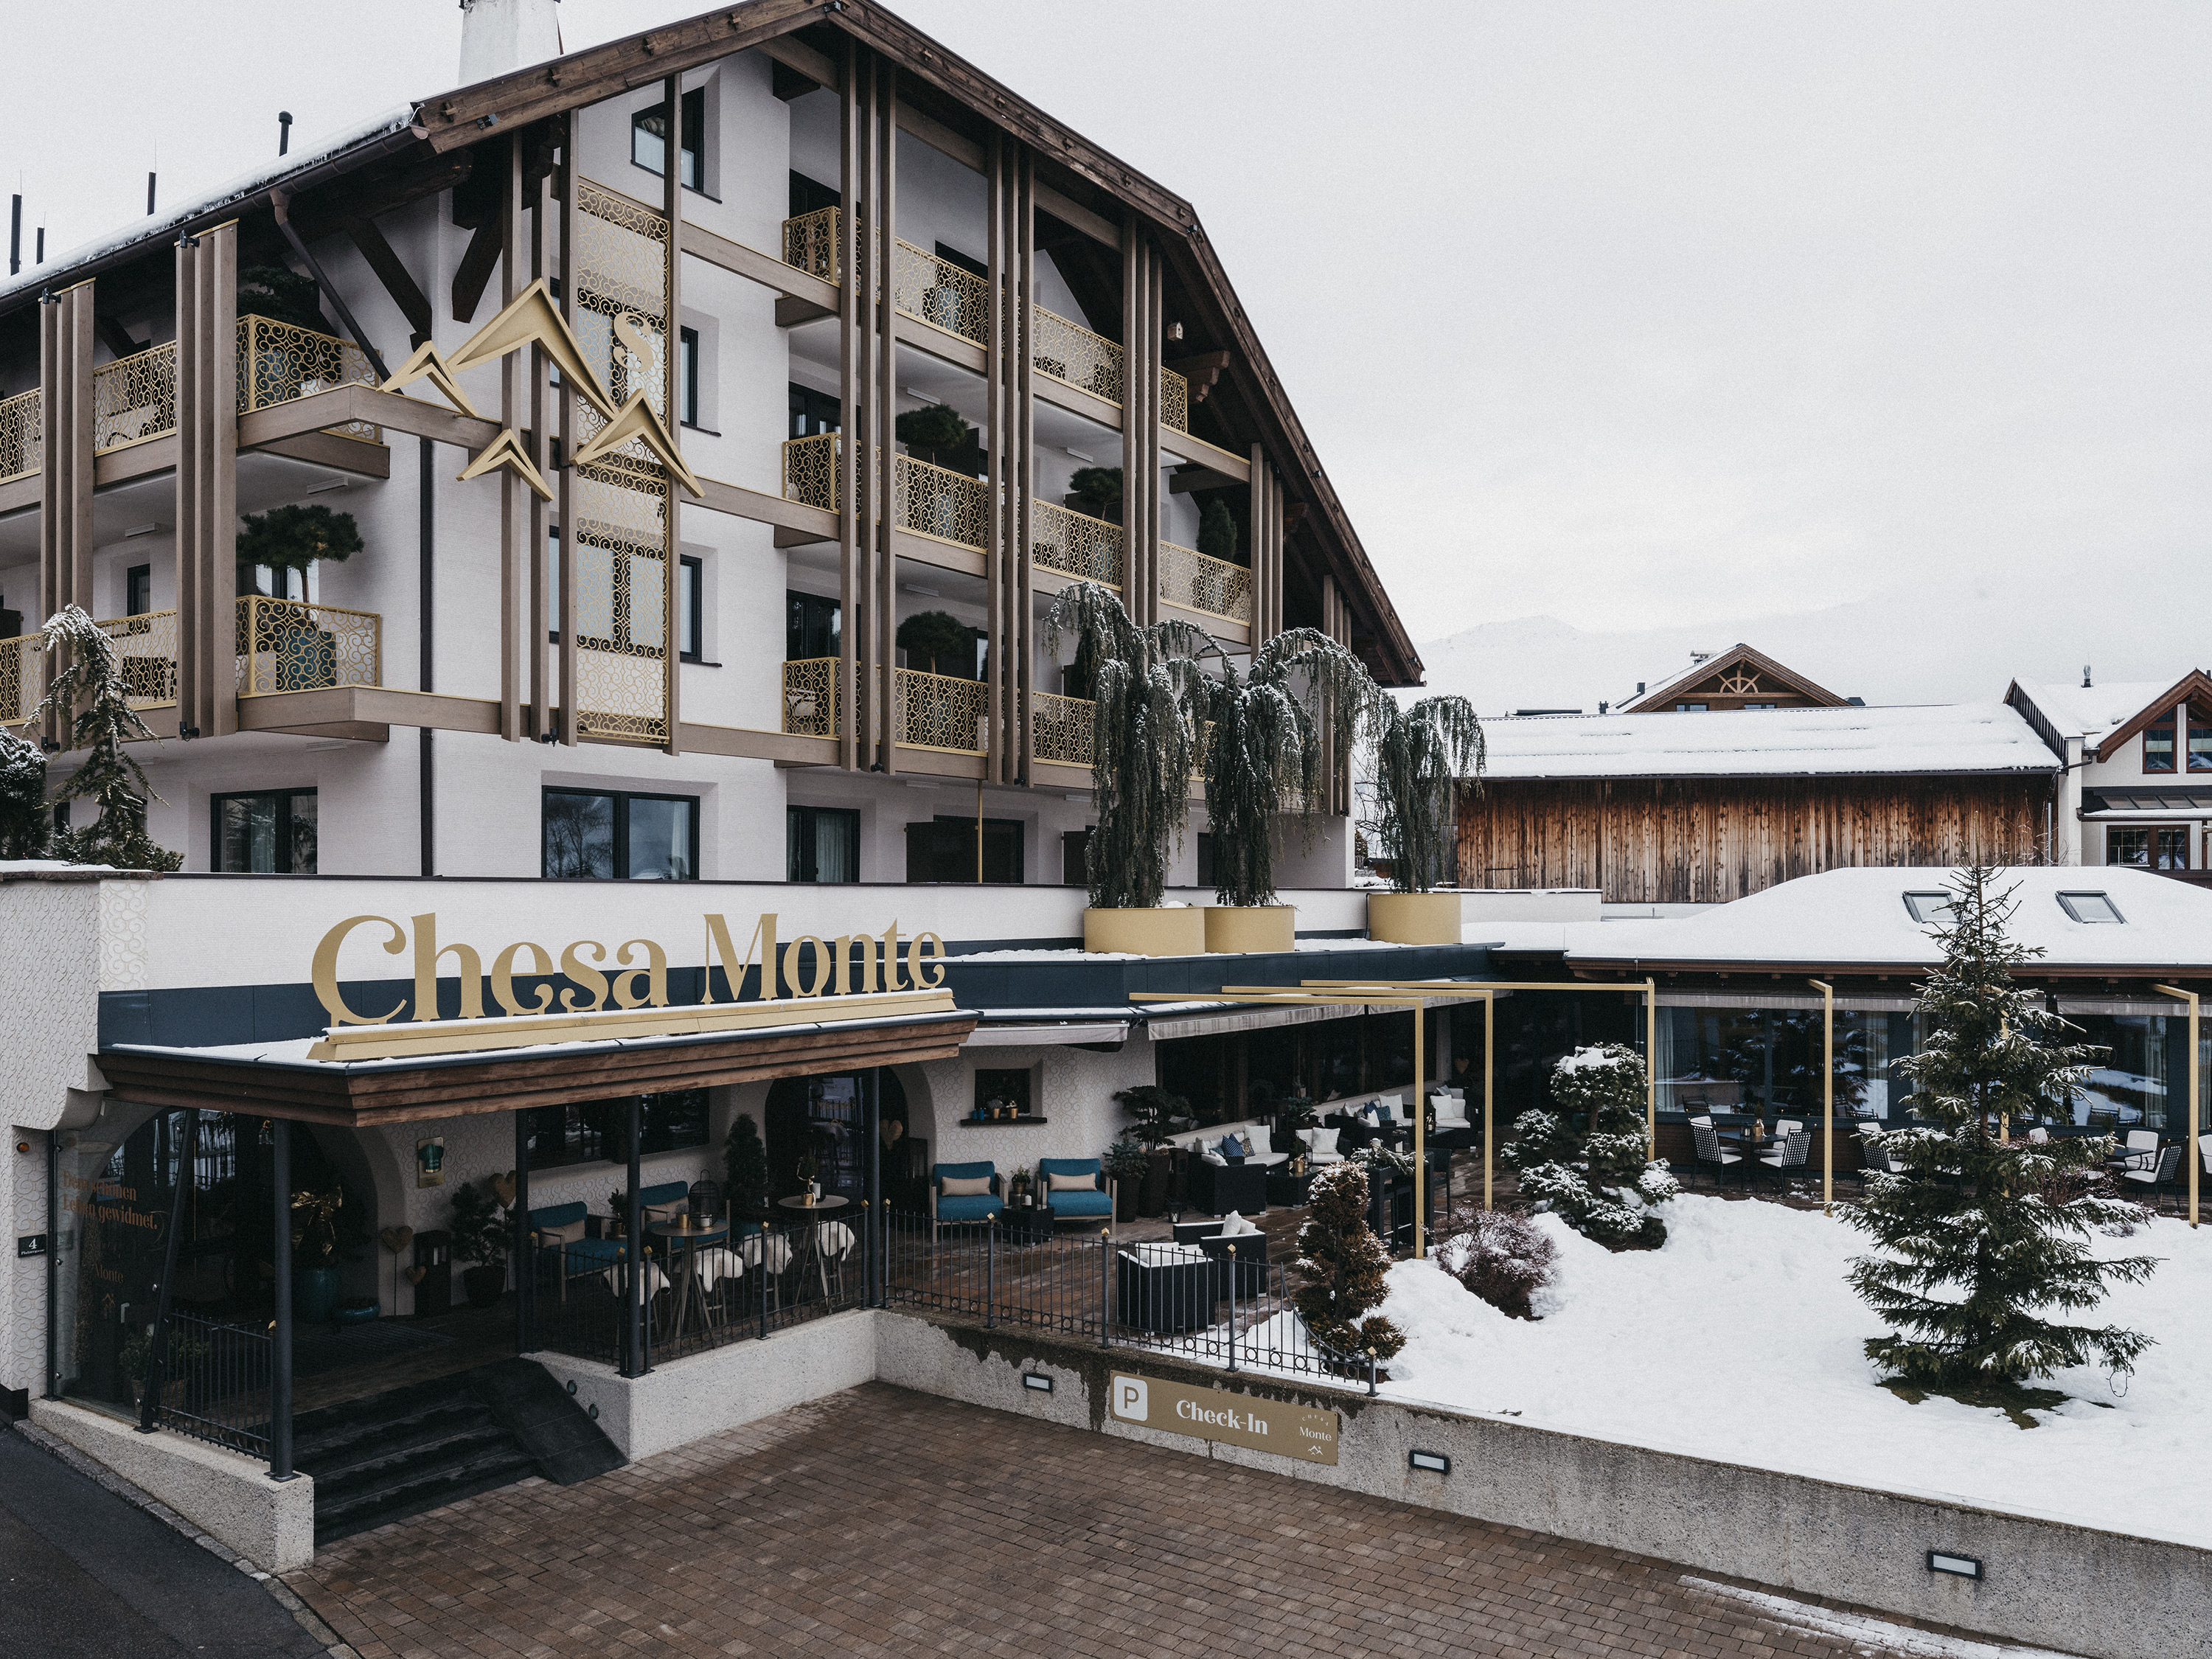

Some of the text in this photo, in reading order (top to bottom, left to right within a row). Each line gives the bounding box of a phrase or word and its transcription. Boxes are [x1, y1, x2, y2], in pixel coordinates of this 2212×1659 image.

[312, 913, 946, 1024] Chesa Monte
[63, 1171, 136, 1201] Dem schönen
[63, 1194, 158, 1230] Leben gewidmet.
[29, 1238, 38, 1250] 4
[94, 1262, 124, 1284] Monte
[1124, 1385, 1139, 1410] P
[1176, 1399, 1268, 1436] Check-In
[1299, 1426, 1332, 1441] Monte
